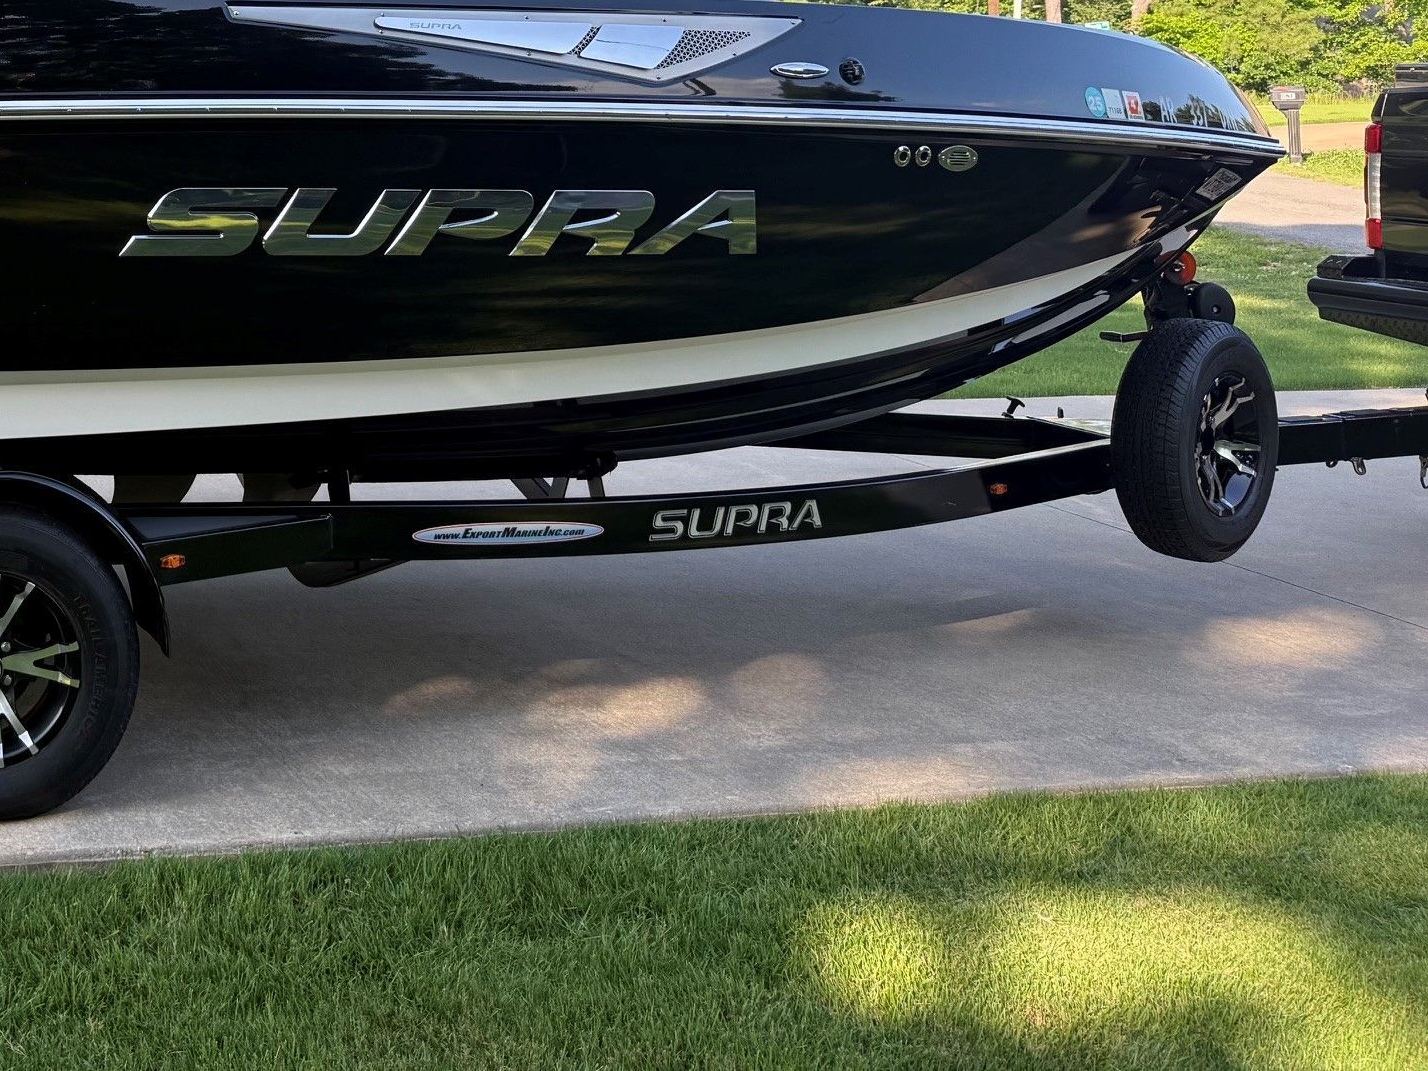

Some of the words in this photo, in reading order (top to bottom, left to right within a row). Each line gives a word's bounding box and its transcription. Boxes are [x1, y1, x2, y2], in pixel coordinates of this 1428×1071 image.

[410, 22, 462, 30] SUPRA
[1087, 96, 1103, 112] 25
[119, 187, 757, 256] SUPRA
[648, 499, 823, 542] SUPRA
